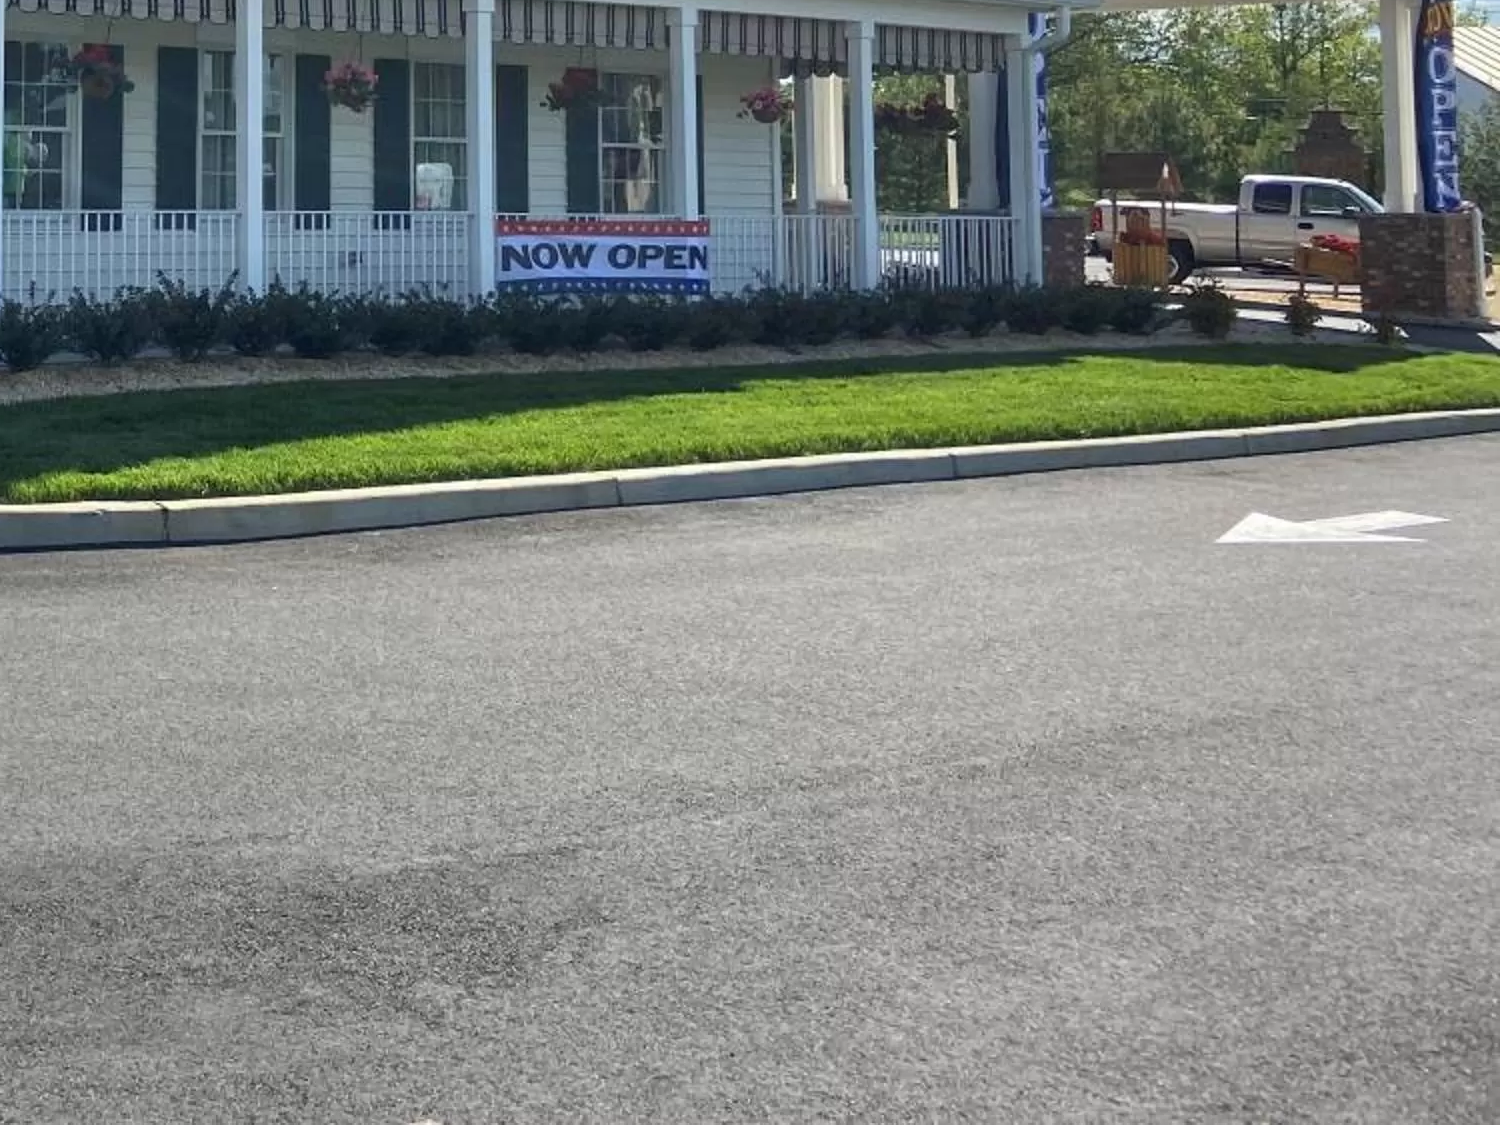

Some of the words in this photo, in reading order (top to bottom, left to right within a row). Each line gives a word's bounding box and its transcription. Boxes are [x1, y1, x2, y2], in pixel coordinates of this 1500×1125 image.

[1429, 46, 1461, 209] OPEN
[501, 242, 597, 272] NOW
[607, 243, 708, 271] OPEN
